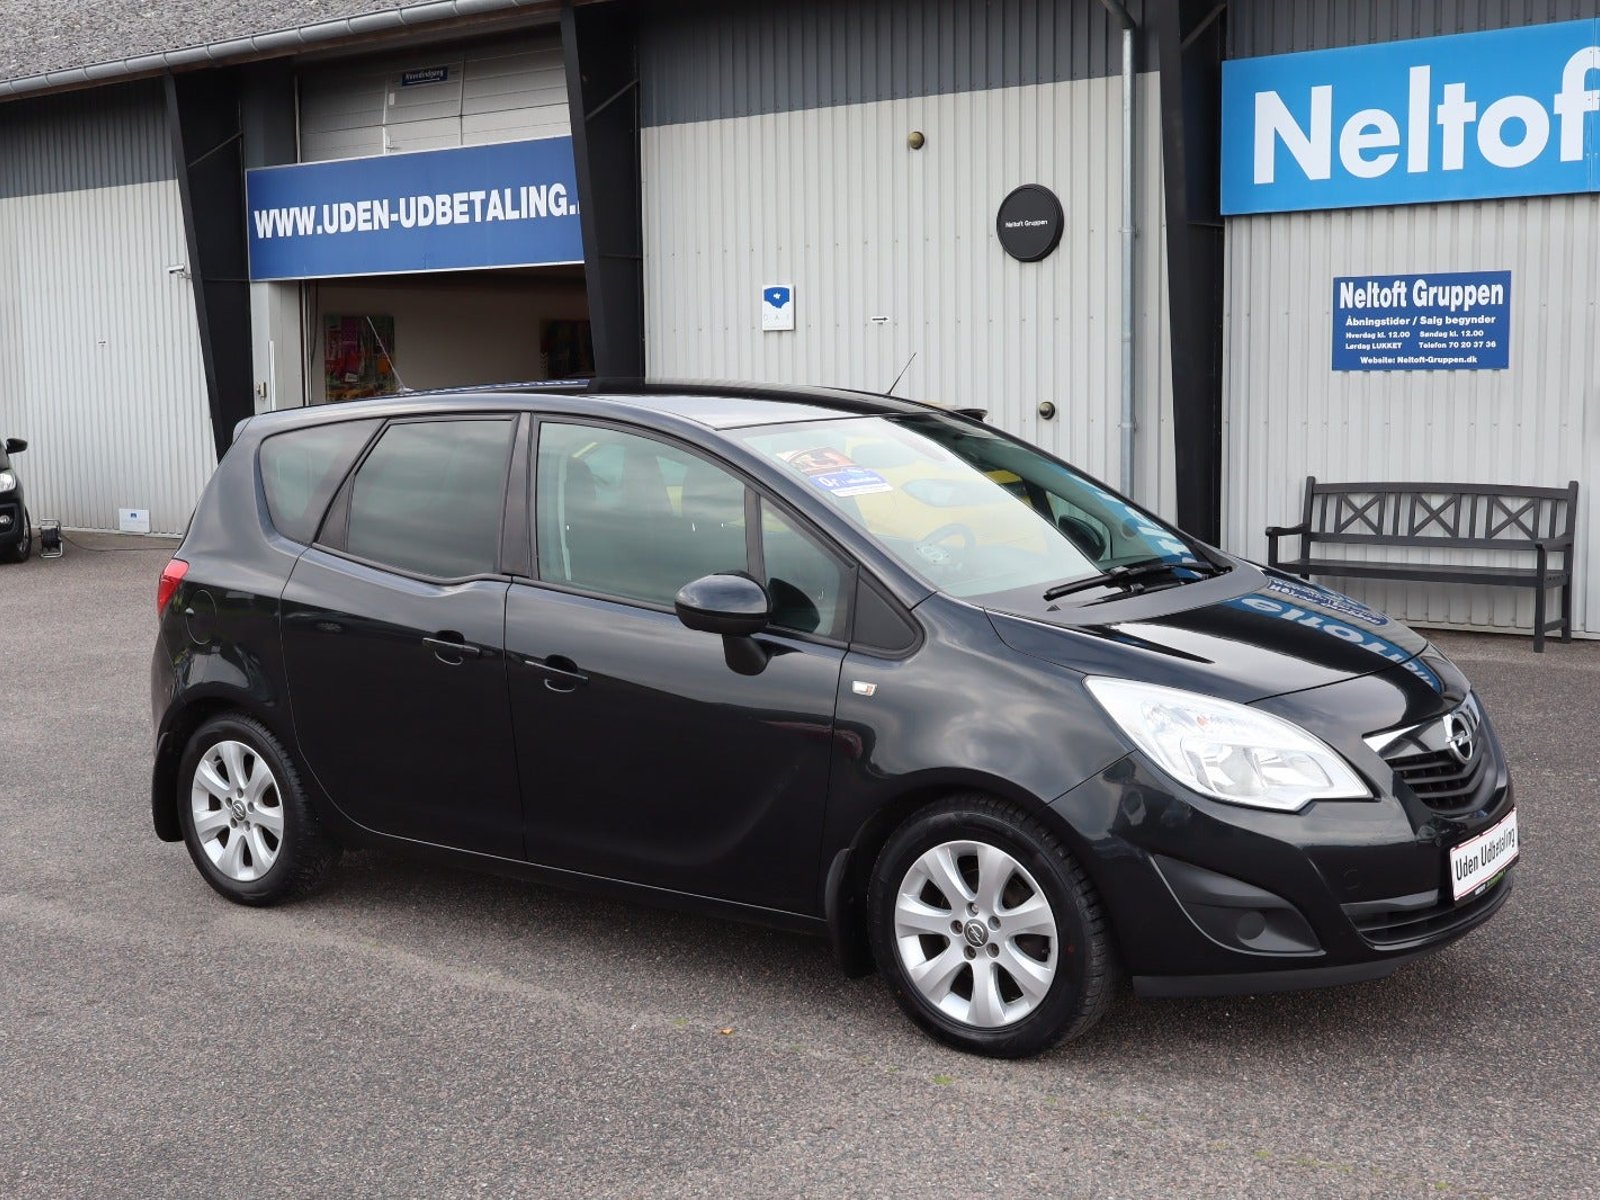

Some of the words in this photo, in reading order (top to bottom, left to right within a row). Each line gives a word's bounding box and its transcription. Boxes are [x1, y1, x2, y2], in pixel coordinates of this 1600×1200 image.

[1254, 46, 1600, 185] Neltof
[254, 182, 580, 239] WWW.UDEN-UDBETALING.
[1005, 220, 1024, 228] Neltoft
[1024, 219, 1048, 227] Gruppen
[1340, 280, 1407, 309] Neltoft
[1412, 278, 1504, 312] Gruppen
[1345, 315, 1411, 327] Åbningstider
[1420, 316, 1443, 326] Salg
[1445, 315, 1496, 326] begynder
[1345, 332, 1376, 340] Hverdag
[1461, 329, 1484, 337] 12.00
[1418, 341, 1447, 349] Telefon
[1448, 341, 1459, 349] 70
[1460, 341, 1472, 349] 20
[1455, 854, 1479, 881] Uden
[1480, 828, 1515, 867] Udbetaling
